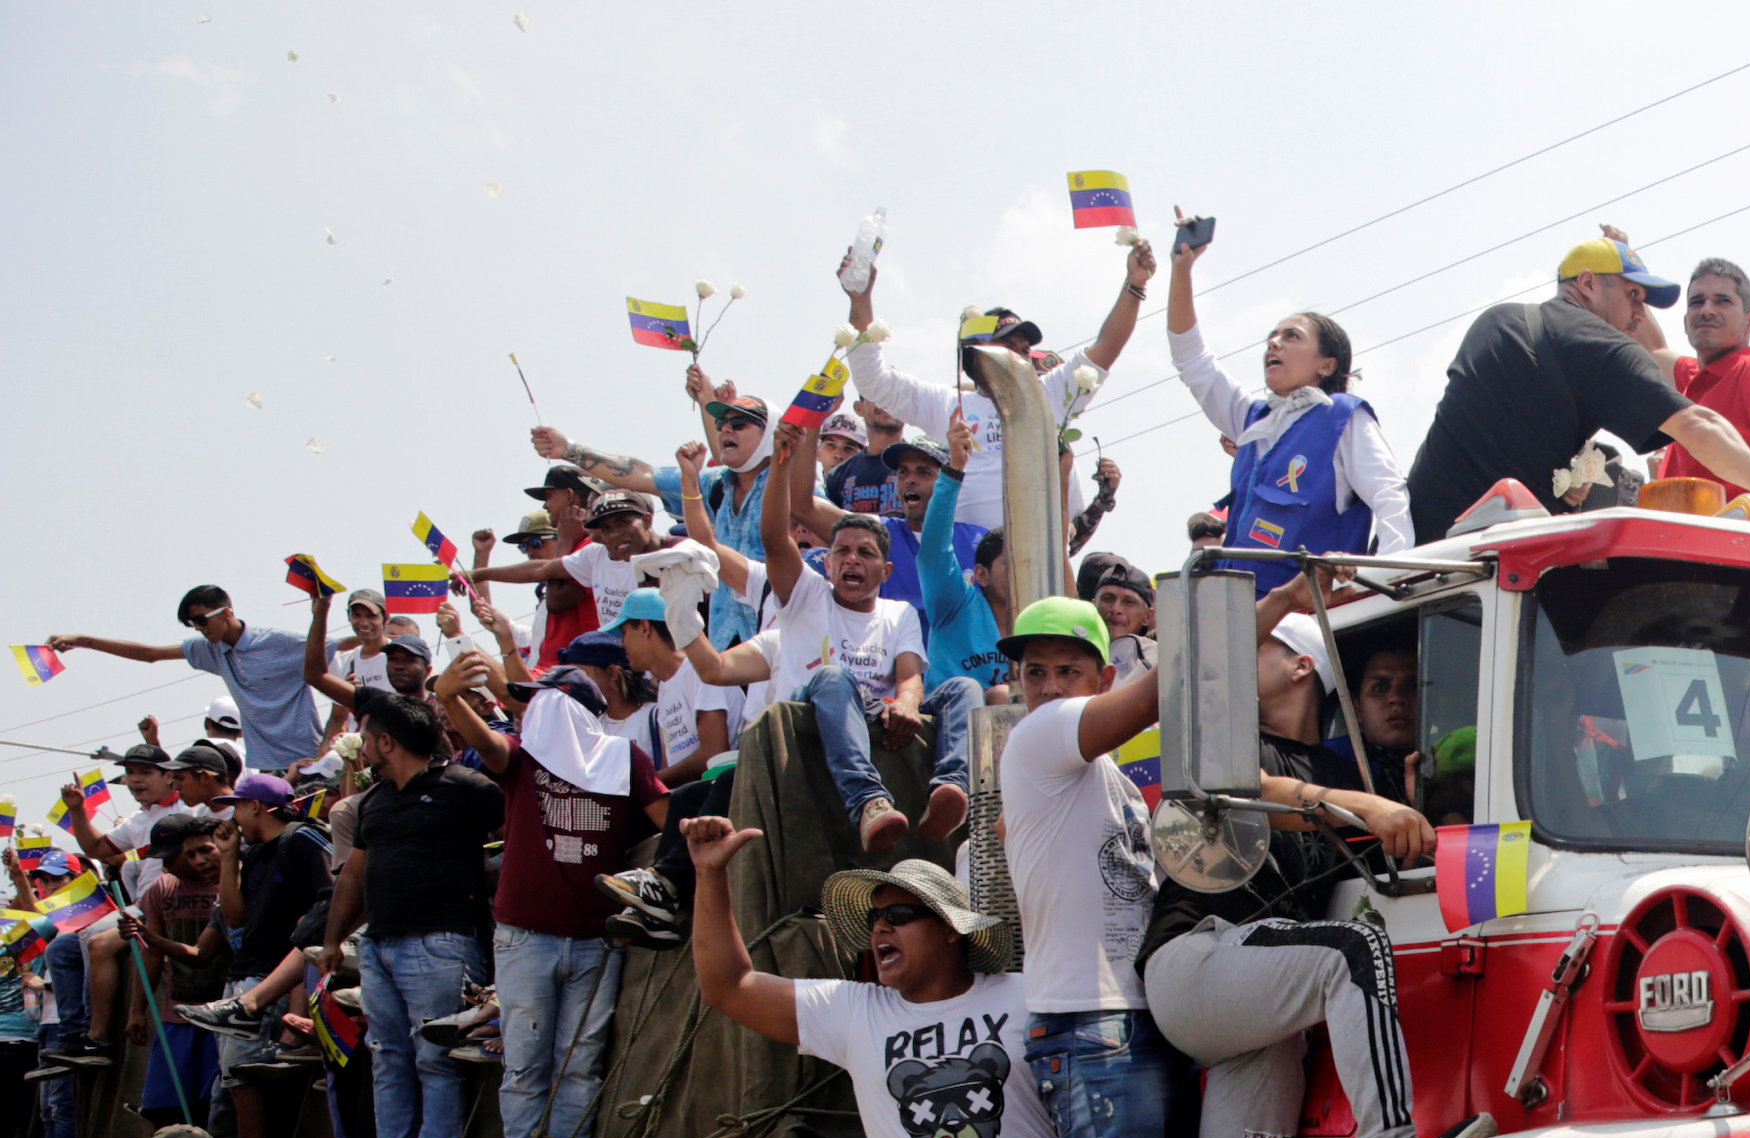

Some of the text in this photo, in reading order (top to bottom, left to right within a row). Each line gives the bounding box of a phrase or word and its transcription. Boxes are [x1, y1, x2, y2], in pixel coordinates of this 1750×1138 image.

[840, 653, 877, 667] Ayuda
[961, 652, 1008, 671] CONFID
[1675, 679, 1721, 738] 4
[1640, 970, 1710, 1012] FORD
[885, 1013, 1010, 1072] RELAX
